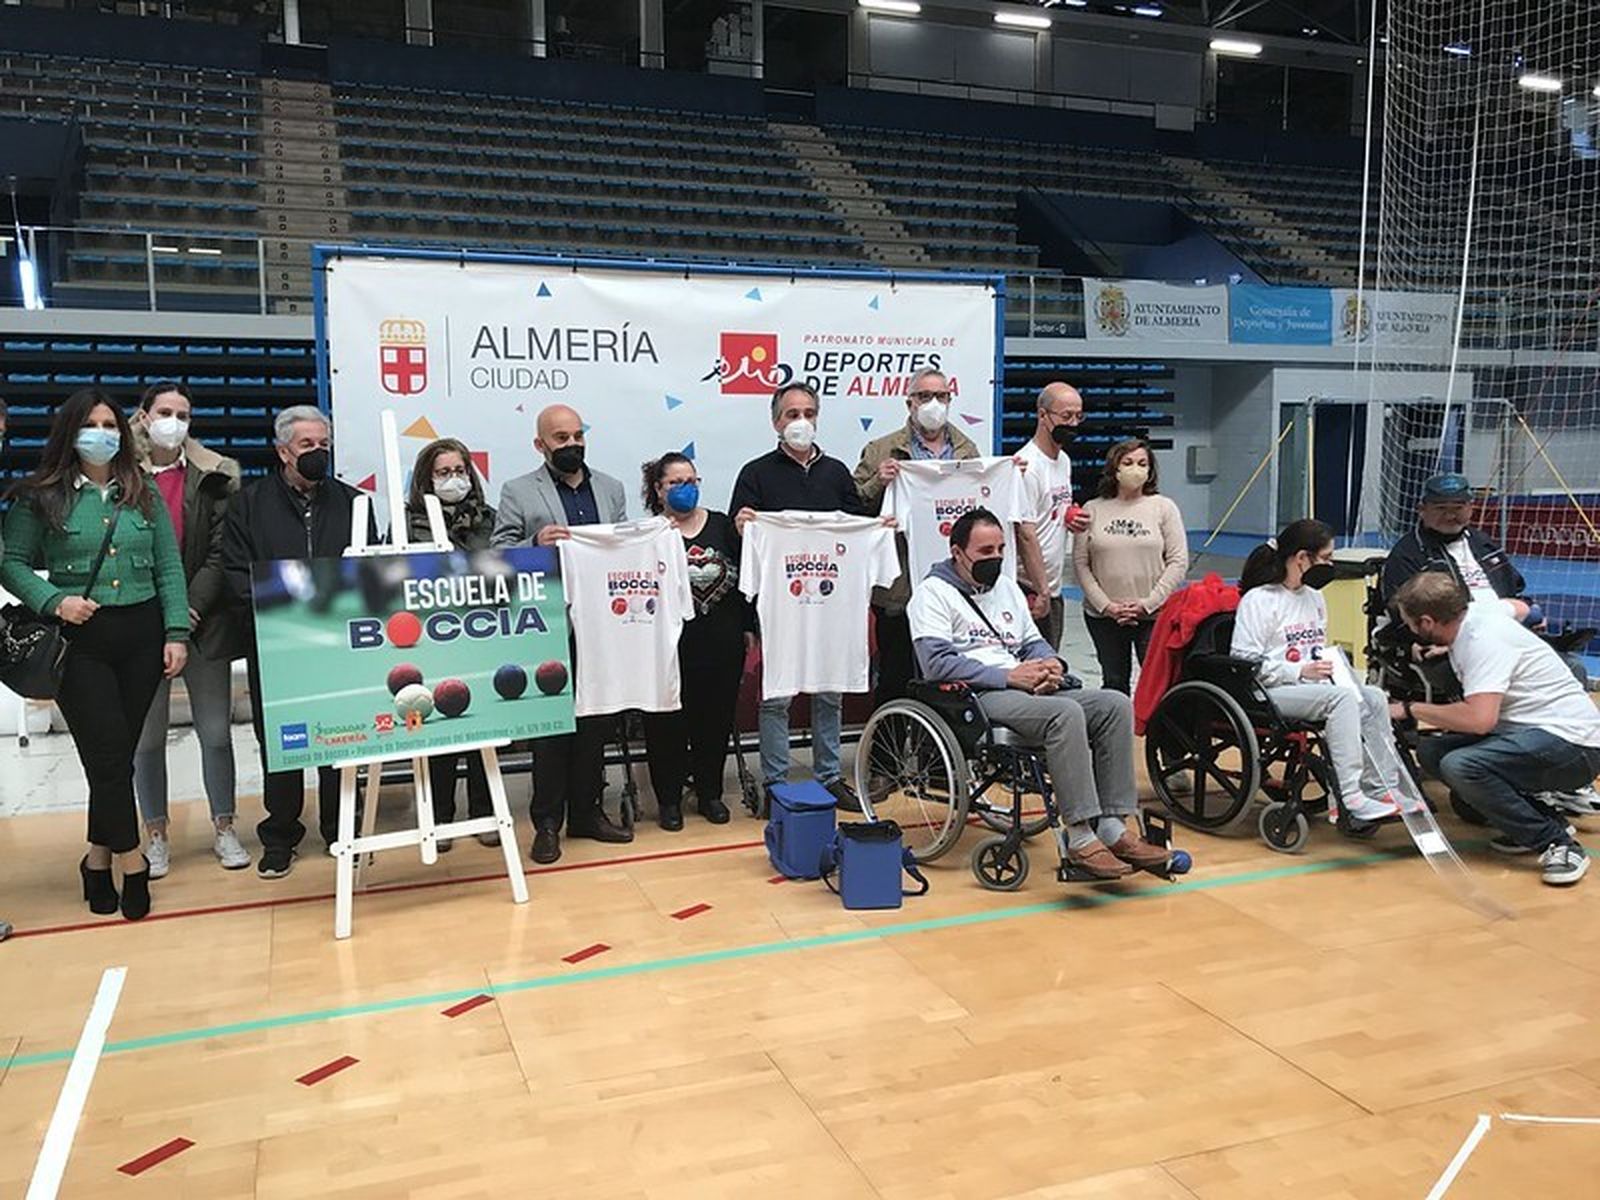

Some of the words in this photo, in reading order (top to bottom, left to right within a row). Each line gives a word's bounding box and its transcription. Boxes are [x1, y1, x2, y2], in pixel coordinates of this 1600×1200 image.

[1134, 303, 1221, 315] AYUNTAMIENTO
[1135, 316, 1148, 326] DE
[471, 321, 659, 364] ALMERÍA
[804, 334, 873, 345] PATRONATO
[877, 336, 939, 346] MUNICIPAL
[941, 337, 957, 346] DE
[804, 351, 942, 373] DEPORTES
[470, 366, 569, 390] CIUDAD
[805, 375, 838, 396] DE
[847, 376, 960, 397] ALMEA
[786, 562, 839, 572] BOCCIA
[404, 573, 511, 610] ESCUELA
[517, 571, 548, 601] DE
[347, 607, 549, 650] BOCCIA
